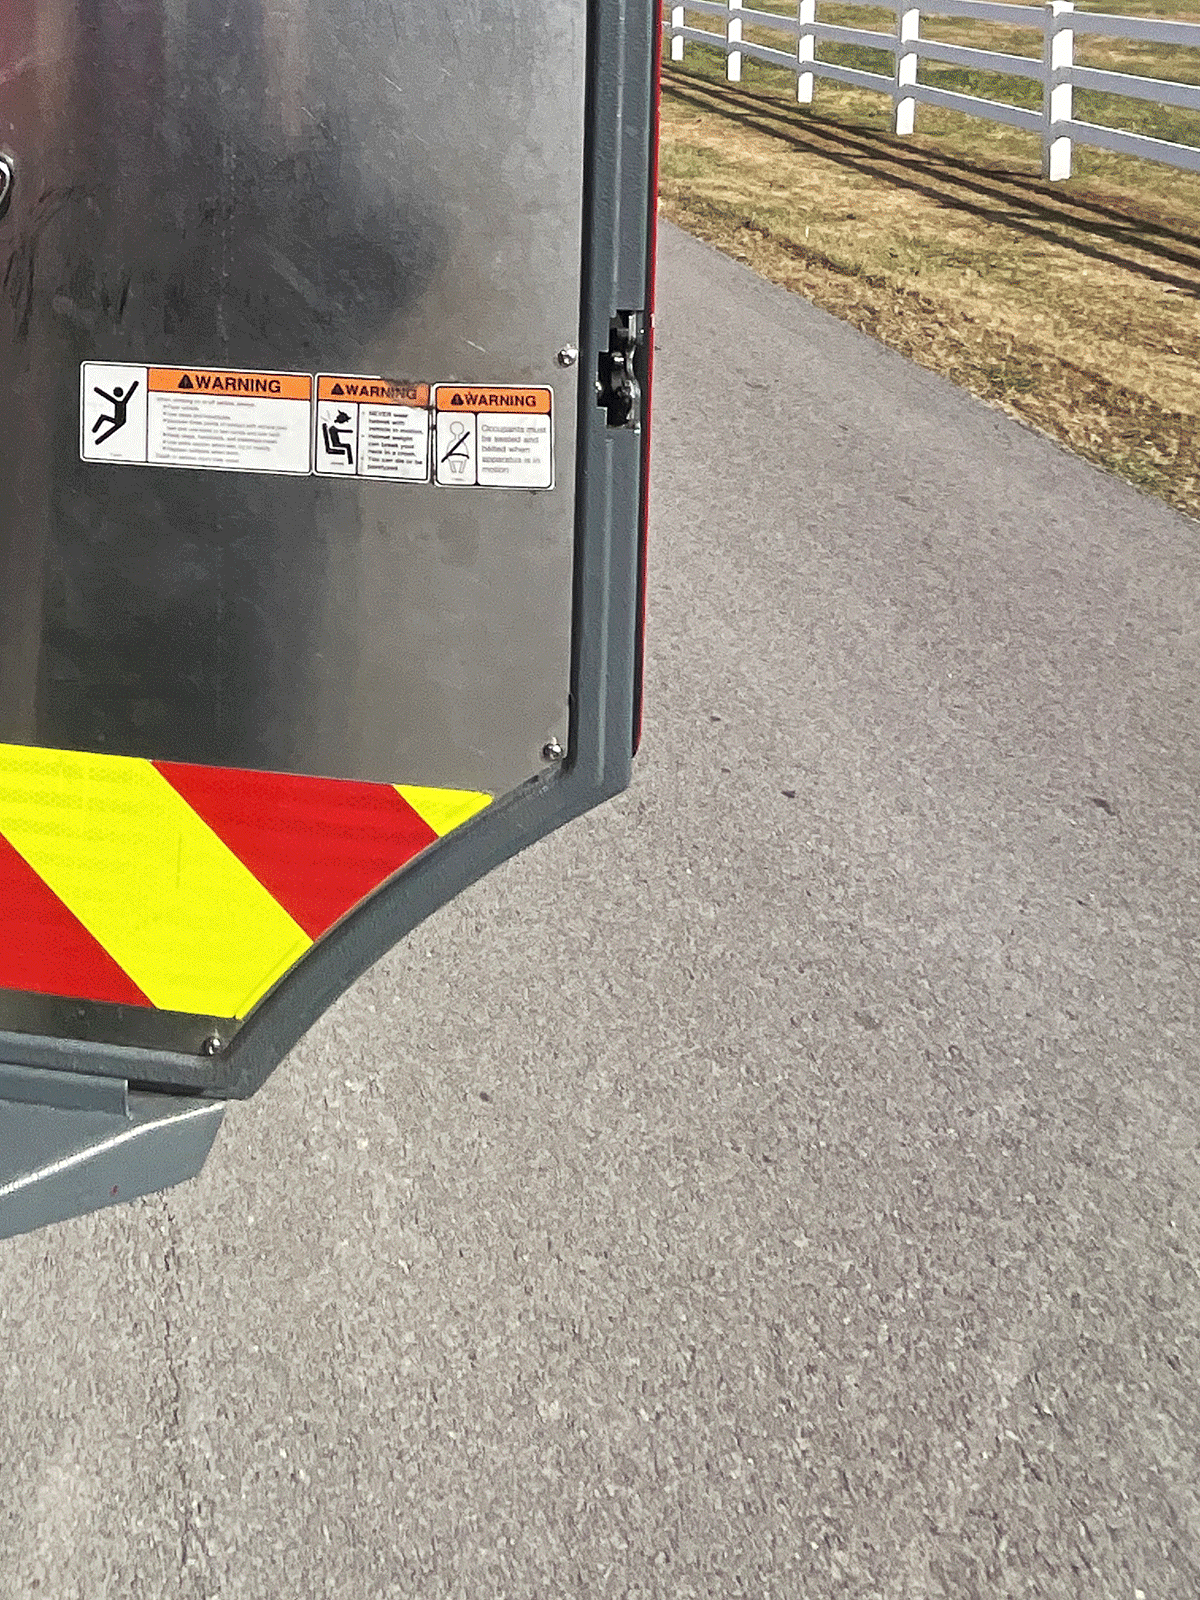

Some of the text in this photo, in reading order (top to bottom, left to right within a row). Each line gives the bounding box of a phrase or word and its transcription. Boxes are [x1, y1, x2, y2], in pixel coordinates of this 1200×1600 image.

[196, 375, 281, 393] WARNING
[345, 384, 417, 400] WARNING
[464, 392, 536, 407] WARNING
